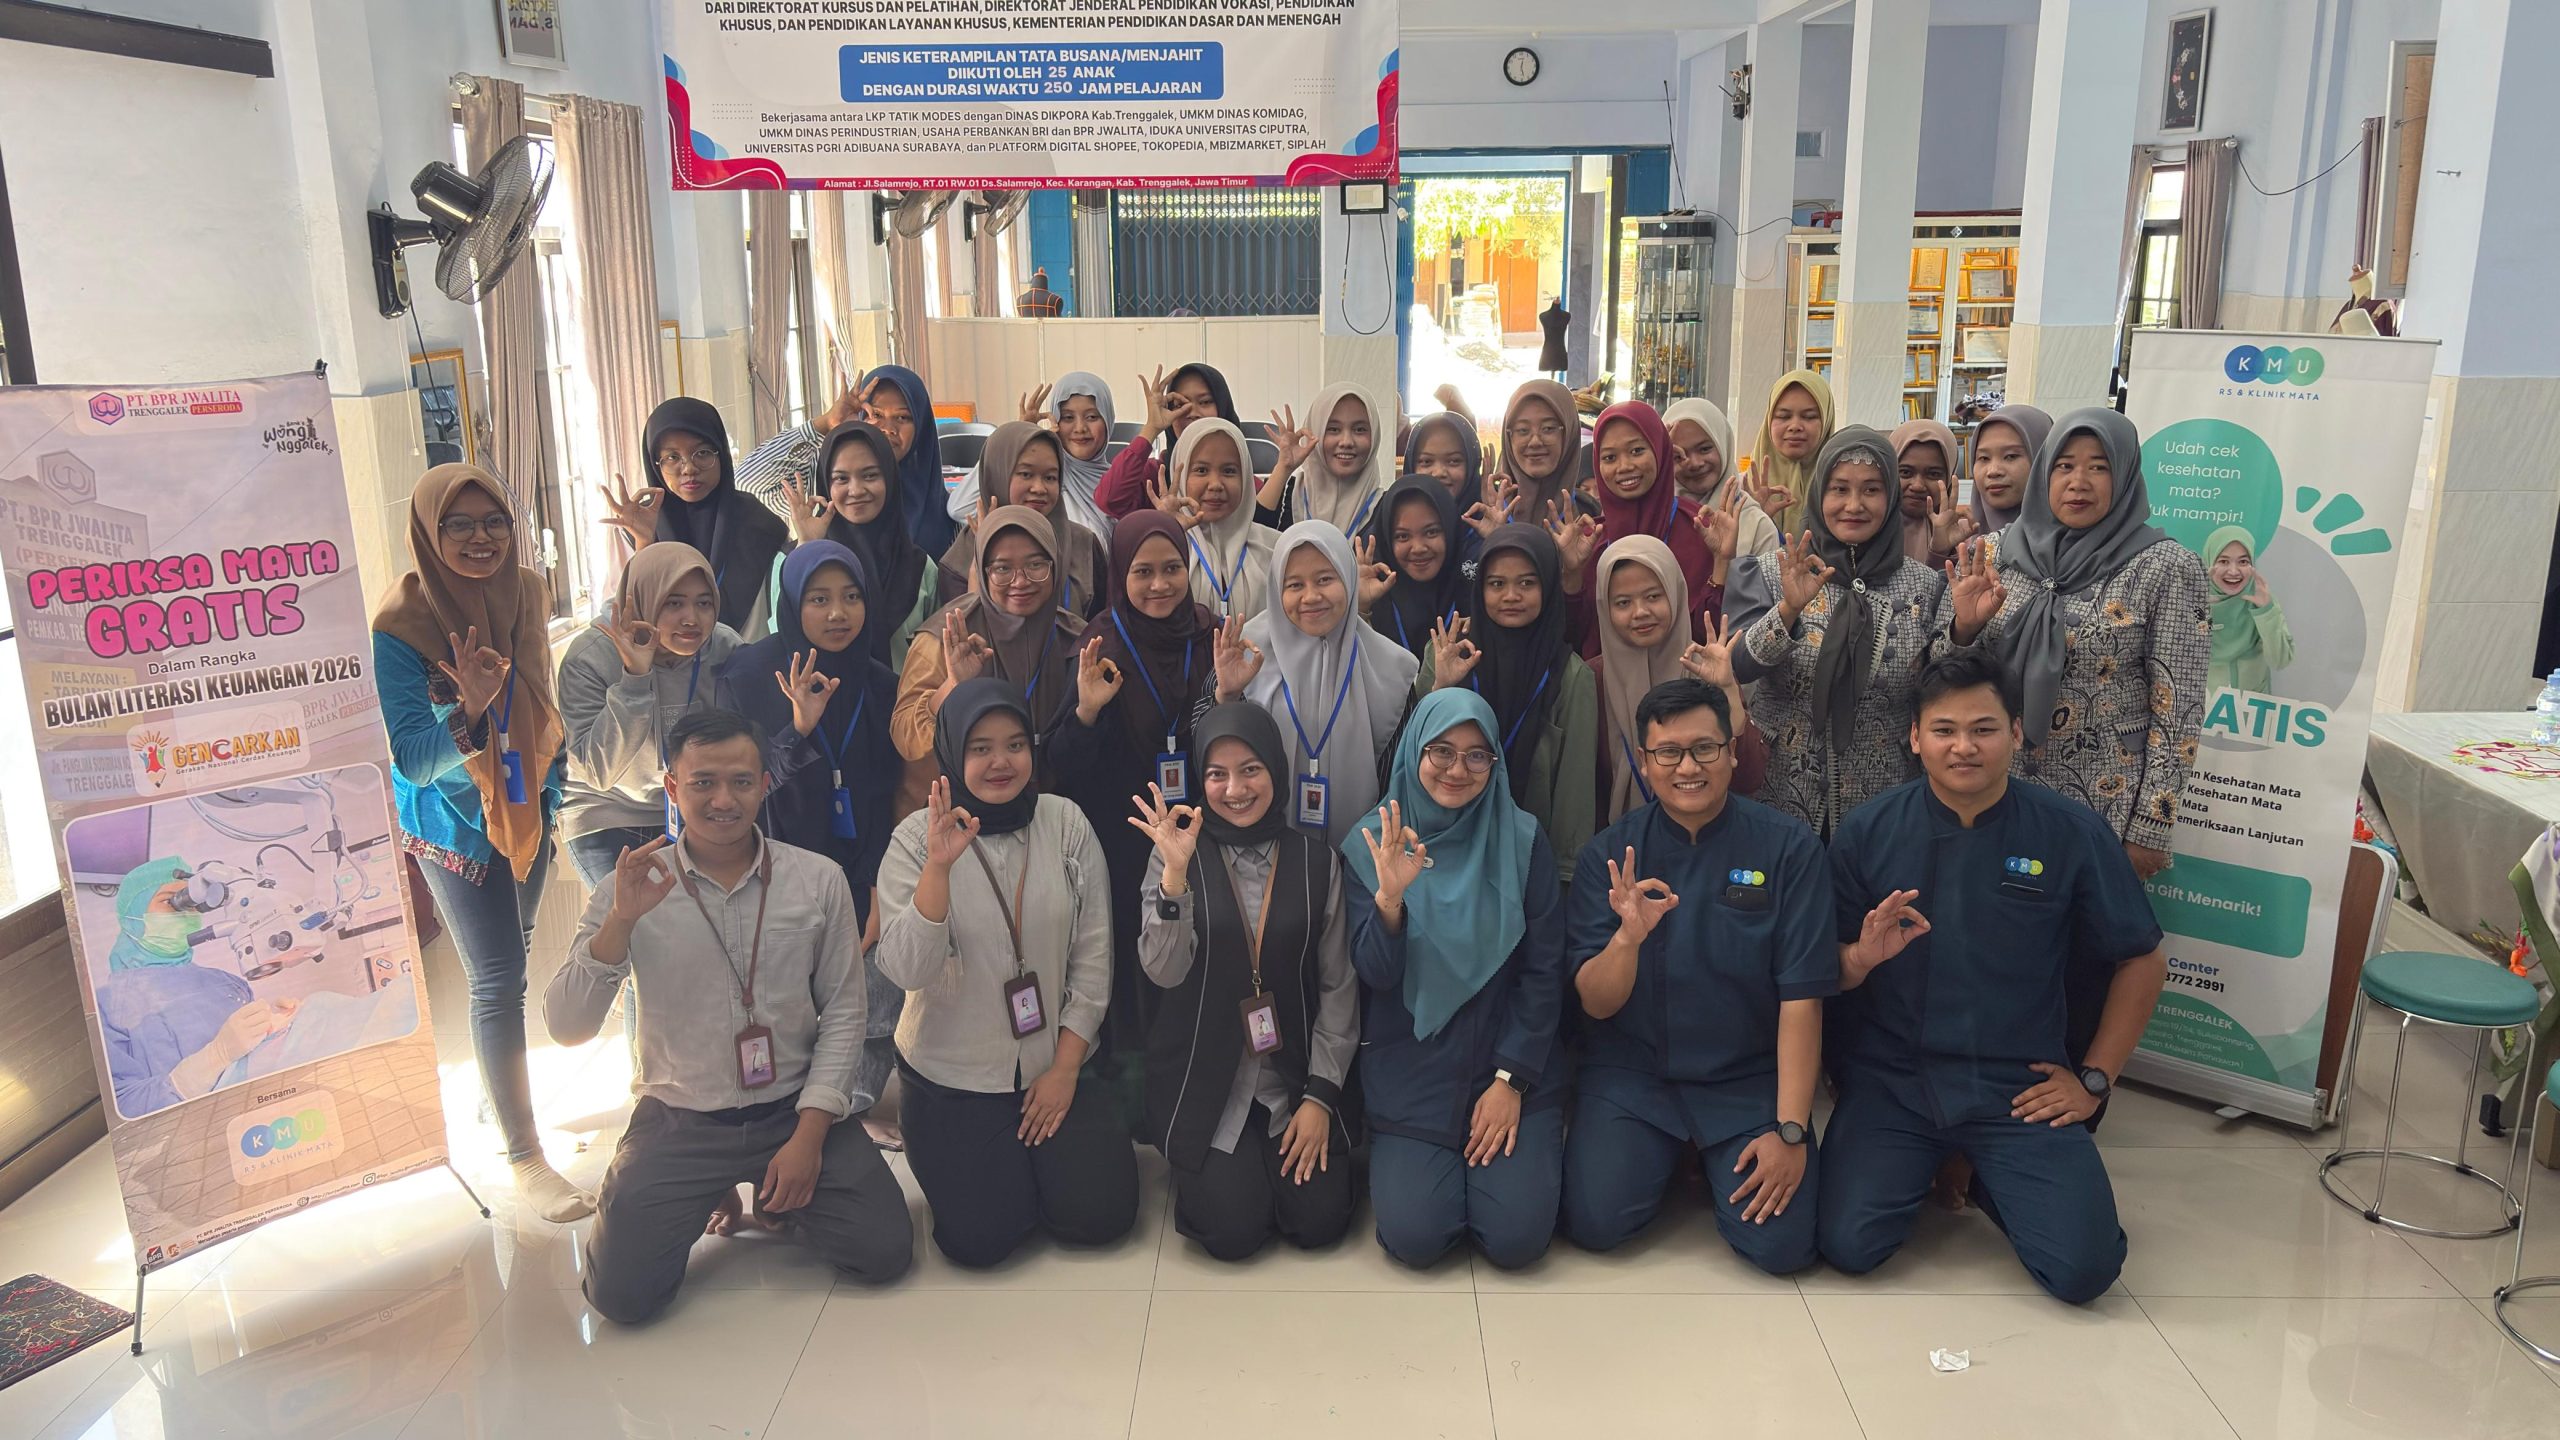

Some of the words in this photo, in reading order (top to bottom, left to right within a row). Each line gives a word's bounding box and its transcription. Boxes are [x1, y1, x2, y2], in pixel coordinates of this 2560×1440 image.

[704, 1, 734, 13] DARI
[736, 1, 819, 13] DIREKTORAT
[821, 1, 873, 13] KURSUS
[876, 0, 903, 12] DAN
[906, 0, 982, 14] PELATIHAN,
[984, 0, 1066, 12] DIREKTORAT
[1069, 0, 1135, 11] JENDERAL
[1138, 0, 1217, 10] PENDIDIKAN
[1220, 0, 1273, 11] VOKASI,
[1276, 0, 1354, 8] PENDIDIKAN
[719, 18, 775, 33] KHUSUS,
[777, 18, 805, 30] DAN
[808, 18, 886, 30] PENDIDIKAN
[888, 17, 951, 30] LAYANAN
[954, 17, 1010, 31] KHUSUS,
[1012, 16, 1105, 28] KEMENTERIAN
[1108, 15, 1186, 28] PENDIDIKAN
[1189, 14, 1234, 27] DASAR
[1236, 14, 1264, 26] DAN
[1267, 12, 1340, 26] MENENGAH
[859, 51, 900, 63] JENIS
[902, 50, 1016, 63] KETERAMPILAN
[1018, 50, 1057, 62] TATA
[1059, 48, 1203, 63] BUSANA/MENJAHIT
[948, 67, 1000, 79] DIIKUTI
[1003, 66, 1041, 78] OLEH
[1048, 66, 1066, 78] 25
[1072, 66, 1115, 78] ANAK
[863, 84, 924, 96] DENGAN
[926, 83, 980, 95] DURASI
[983, 83, 1038, 95] WAKTU
[1044, 81, 1072, 93] 250
[1078, 82, 1111, 94] JAM
[1114, 81, 1201, 94] PELAJARAN
[761, 112, 827, 124] Bekerjasama
[829, 112, 863, 122] antara
[865, 111, 885, 121] LKP
[888, 111, 918, 121] TATIK
[921, 111, 961, 121] MODES
[963, 111, 1002, 123] dengan
[1005, 110, 1038, 120] DINAS
[1041, 110, 1089, 120] DIKPORA
[1092, 109, 1176, 122] Kab.Trenggalek,
[1179, 109, 1214, 119] UMKM
[1216, 108, 1250, 118] DINAS
[1252, 108, 1306, 120] KOMIDAG,
[759, 128, 792, 138] UMKM
[795, 127, 828, 137] DINAS
[830, 127, 919, 138] PERINDUSTRIAN,
[922, 127, 960, 136] USAHA
[963, 126, 1029, 136] PERBANKAN
[1032, 126, 1048, 136] BRI
[1051, 126, 1070, 136] dan
[1073, 126, 1094, 135] BPR
[1096, 125, 1146, 137] JWALITA,
[1149, 125, 1183, 135] IDUKA
[1185, 124, 1256, 135] UNIVERSITAS
[1259, 124, 1309, 135] CIPUTRA,
[744, 143, 814, 153] UNIVERSITAS
[816, 143, 840, 152] PGRI
[843, 142, 900, 152] ADIBUANA
[902, 142, 964, 153] SURABAYA,
[966, 142, 986, 152] dan
[988, 142, 1046, 152] PLATFORM
[1049, 141, 1091, 151] DIGITAL
[1094, 141, 1139, 152] SHOPEE,
[1142, 140, 1207, 152] TOKOPEDIA,
[1209, 140, 1284, 151] MBIZMARKET,
[1287, 139, 1326, 149] SIPLAH
[824, 179, 856, 188] Alamat
[862, 179, 921, 190] Jl.Salamrejo,
[922, 179, 948, 187] RT.01
[950, 179, 979, 187] RW.01
[981, 179, 1044, 188] Ds.Salamrejo,
[1046, 178, 1065, 187] Kec.
[1067, 179, 1114, 189] Karangan,
[1116, 178, 1136, 186] Kab.
[1138, 178, 1192, 188] Trenggalek,
[1194, 178, 1219, 188] Jawa
[1220, 177, 1250, 188] Timur
[126, 394, 148, 407] PT.
[150, 393, 180, 406] BPR
[182, 390, 241, 404] JWALITA
[2218, 388, 2232, 396] RS
[2248, 390, 2286, 399] KLINIK
[2288, 392, 2320, 401] MATA
[128, 406, 188, 417] TRENGGALEK
[192, 403, 241, 414] PERSERODA
[276, 440, 328, 454] Nggalek
[2166, 441, 2205, 456] Udah
[2210, 444, 2240, 458] cek
[2158, 460, 2240, 480] kesehatan
[2169, 486, 2221, 500] mata?
[2149, 503, 2169, 517] uk
[2173, 508, 2244, 525] mampir!
[28, 504, 64, 532] BPR
[67, 513, 134, 545] JWALITA
[16, 524, 124, 558] TRENGGALEK
[27, 553, 213, 610] PERIKSA
[221, 540, 340, 584] MATA
[85, 583, 304, 658] GRATIS
[148, 658, 196, 676] Dalam
[200, 651, 256, 668] Rangka
[51, 670, 120, 686] MELAYANI
[43, 690, 114, 728] BULAN
[114, 678, 203, 715] LITERASI
[206, 662, 308, 705] KEUANGAN
[311, 654, 362, 684] 2026
[2202, 692, 2328, 748] ATIS
[172, 726, 301, 768] GENCARKAN
[176, 765, 205, 775] Gerakan
[208, 758, 239, 770] Nasional
[239, 754, 266, 764] Cerdas
[267, 748, 300, 760] Keuangan
[2204, 771, 2266, 792] Kesehatan
[2268, 784, 2302, 798] Mata
[2182, 798, 2209, 812] Mata
[2188, 784, 2248, 804] Kesehatan
[2251, 796, 2282, 811] Mata
[2177, 815, 2244, 836] emeriksaan
[2248, 828, 2304, 847] Lanjutan
[2158, 884, 2184, 900] Gift
[2187, 890, 2262, 917] Menarik!
[2168, 957, 2220, 976] Center
[2196, 978, 2225, 993] 2991
[2157, 1004, 2234, 1030] TRENGGALEK
[257, 1087, 297, 1104] Bersama
[148, 1252, 164, 1263] BPR
